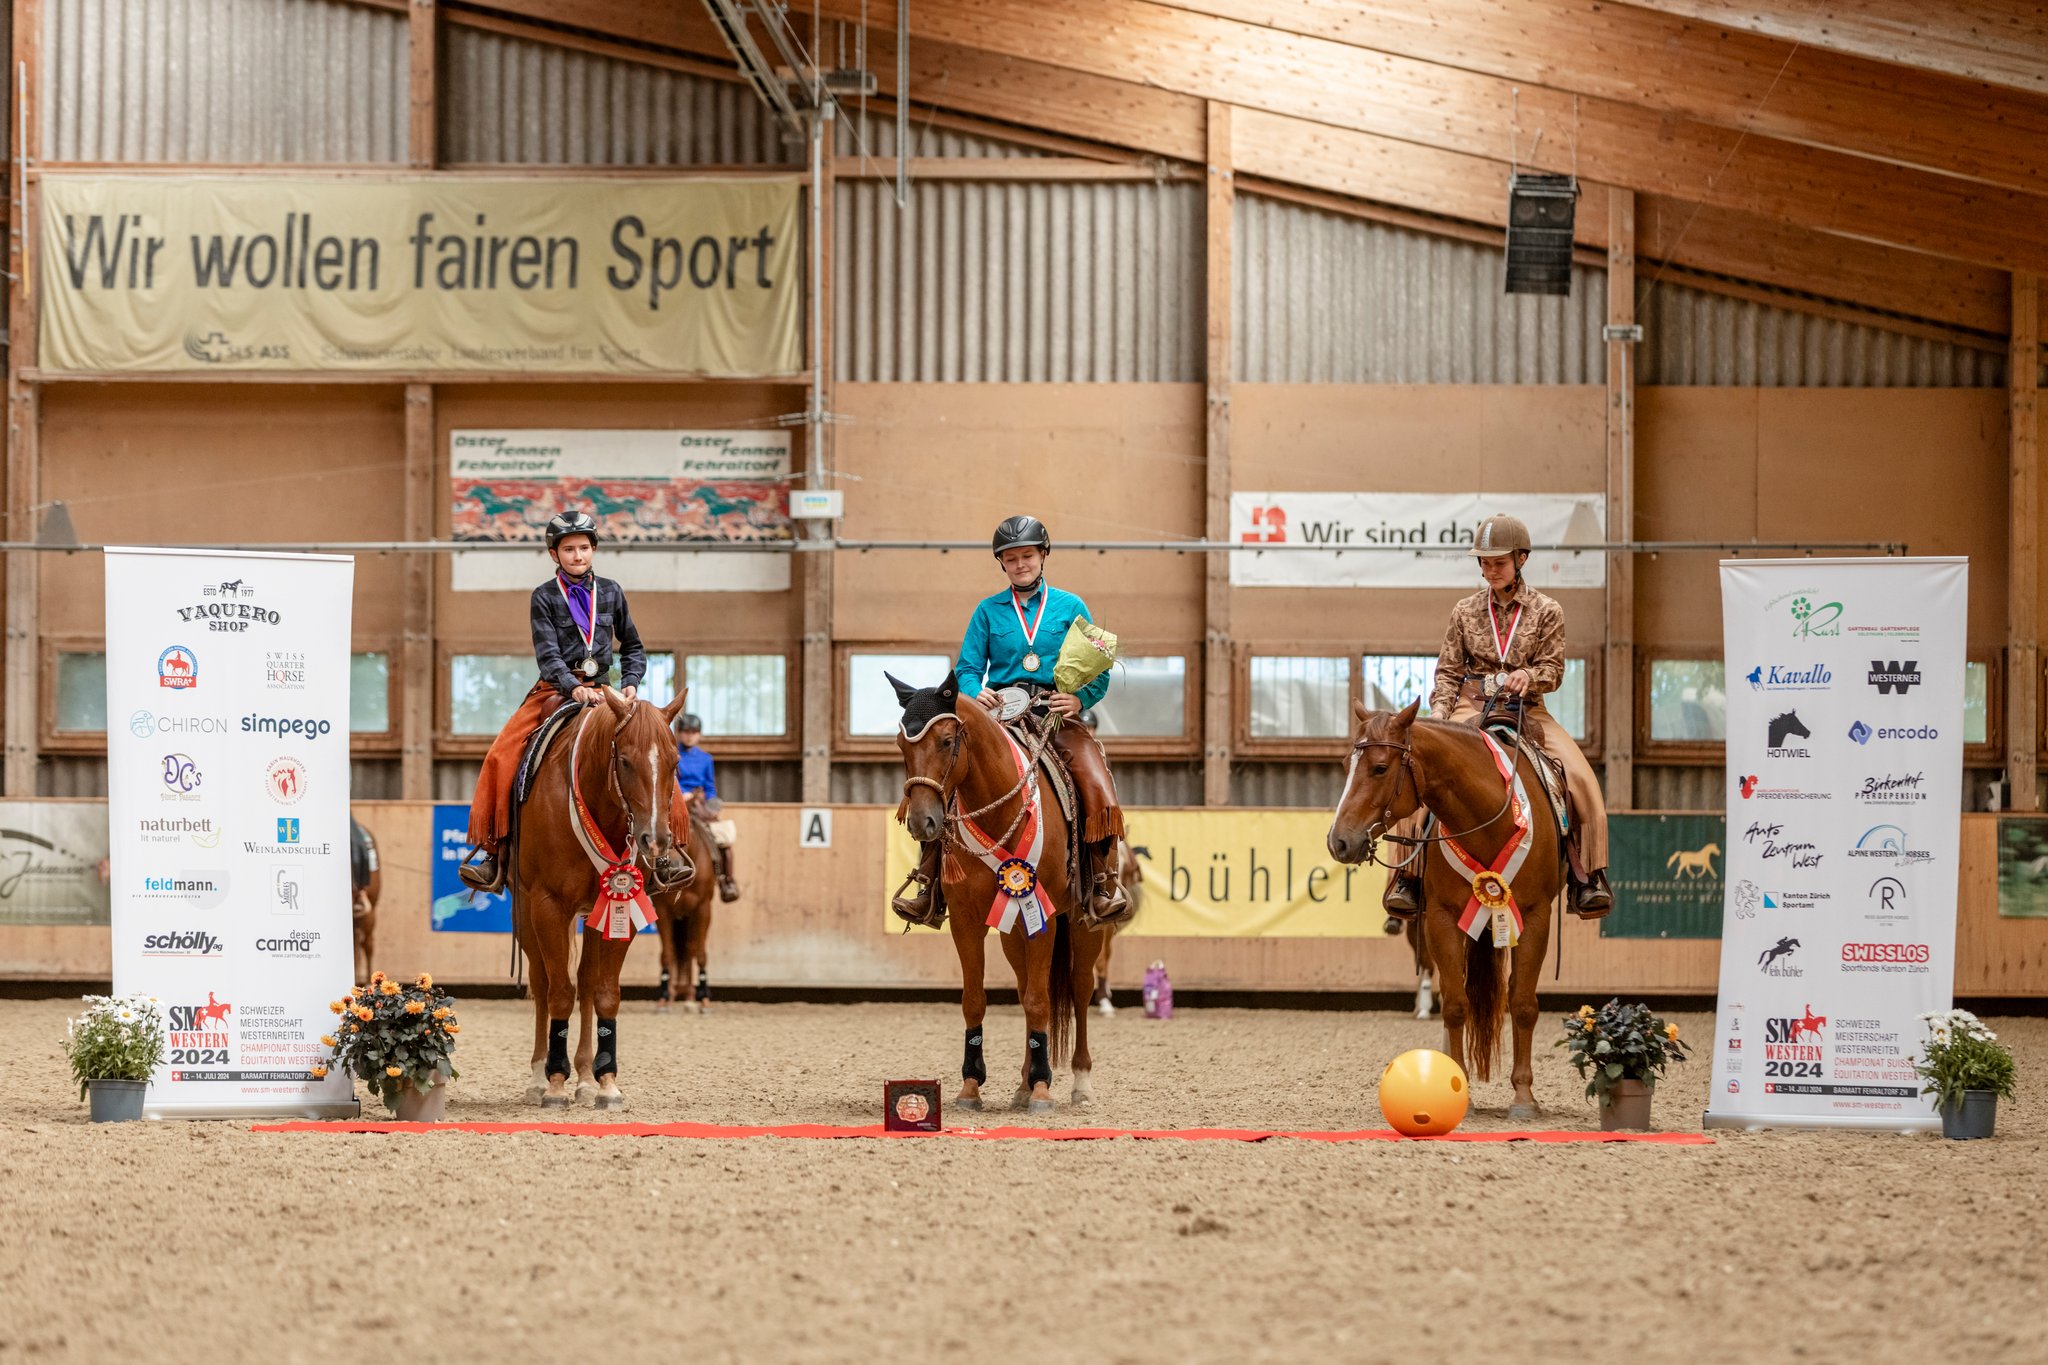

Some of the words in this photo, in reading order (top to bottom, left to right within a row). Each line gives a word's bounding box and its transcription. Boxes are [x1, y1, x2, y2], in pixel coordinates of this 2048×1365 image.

[65, 213, 164, 290] Wir
[191, 213, 380, 291] wollen
[409, 213, 578, 290] fairen
[607, 215, 776, 310] Sport
[260, 345, 290, 359] ASS
[454, 436, 507, 447] Oster
[680, 436, 733, 447] Oster
[495, 446, 562, 456] rennen
[721, 446, 787, 456] rennen
[457, 459, 555, 471] Fehraltorf
[683, 459, 780, 471] Fehraltorf
[1301, 521, 1354, 544] Wir
[1366, 521, 1427, 544] sind
[203, 588, 217, 596] ESTD
[241, 589, 254, 597] 1977
[176, 602, 281, 626] VAQUERO
[209, 621, 250, 632] SHOP
[266, 652, 305, 660] SWISS
[266, 661, 305, 669] QUARTER
[266, 670, 305, 684] HORSE
[1767, 664, 1832, 684] Kavallo
[1869, 674, 1920, 683] WESTERNER
[163, 677, 190, 686] SWRA
[158, 716, 228, 733] CHIRON
[241, 713, 331, 740] simpego
[1878, 725, 1939, 740] encodo
[1767, 749, 1811, 758] HOTWIEL
[1862, 771, 1925, 794] Birkenhof
[1855, 791, 1927, 800] PFERDEPENSION
[140, 818, 212, 832] naturbett
[579, 805, 605, 850] Meisterschaft
[806, 813, 827, 843] A
[141, 834, 149, 842] lit
[151, 834, 181, 843] naturel
[1743, 821, 1784, 844] Auto
[244, 841, 331, 855] WEINLANDSCHULE
[1762, 840, 1816, 859] Zentrum
[1792, 854, 1824, 869] West
[1170, 847, 1360, 902] bühler
[145, 878, 218, 892] feldmann.
[1809, 891, 1831, 900] Zürich
[1881, 886, 1895, 910] R
[1782, 901, 1815, 910] Sportamt
[144, 931, 217, 954] schölly
[213, 943, 223, 952] ag
[290, 930, 321, 943] design
[256, 938, 311, 952] carma
[1842, 943, 1930, 962] SWISSLOS
[1841, 964, 1880, 973] Sportfonds
[1881, 965, 1907, 973] Kanton
[1908, 965, 1930, 974] Zürich
[240, 1006, 285, 1015] SCHWEIZER
[169, 1006, 203, 1031] SM
[240, 1019, 303, 1028] MEISTERSCHAFT
[1835, 1019, 1880, 1029] SCHWEIZER
[240, 1031, 305, 1040] WESTERNREITEN
[1765, 1018, 1799, 1044] SM
[1835, 1032, 1899, 1042] MEISTERSCHAFT
[170, 1033, 229, 1048] WESTERN
[240, 1044, 290, 1052] CHAMPIONAT
[293, 1044, 320, 1052] SUISSE
[1765, 1045, 1823, 1061] WESTERN
[1834, 1044, 1900, 1055] WESTERNREITEN
[170, 1050, 230, 1065] 2024
[288, 1056, 325, 1065] WESTERN
[1834, 1057, 1885, 1067] CHAMPIONAT
[1765, 1061, 1823, 1078] 2024
[1882, 1071, 1919, 1081] WESTERN
[241, 1086, 310, 1094] www.sm-western.ch
[1775, 1085, 1783, 1093] 12.
[1788, 1085, 1797, 1093] 14.
[1862, 1088, 1899, 1096] FEHRALTORF
[1833, 1101, 1902, 1110] www.sm-western.ch
